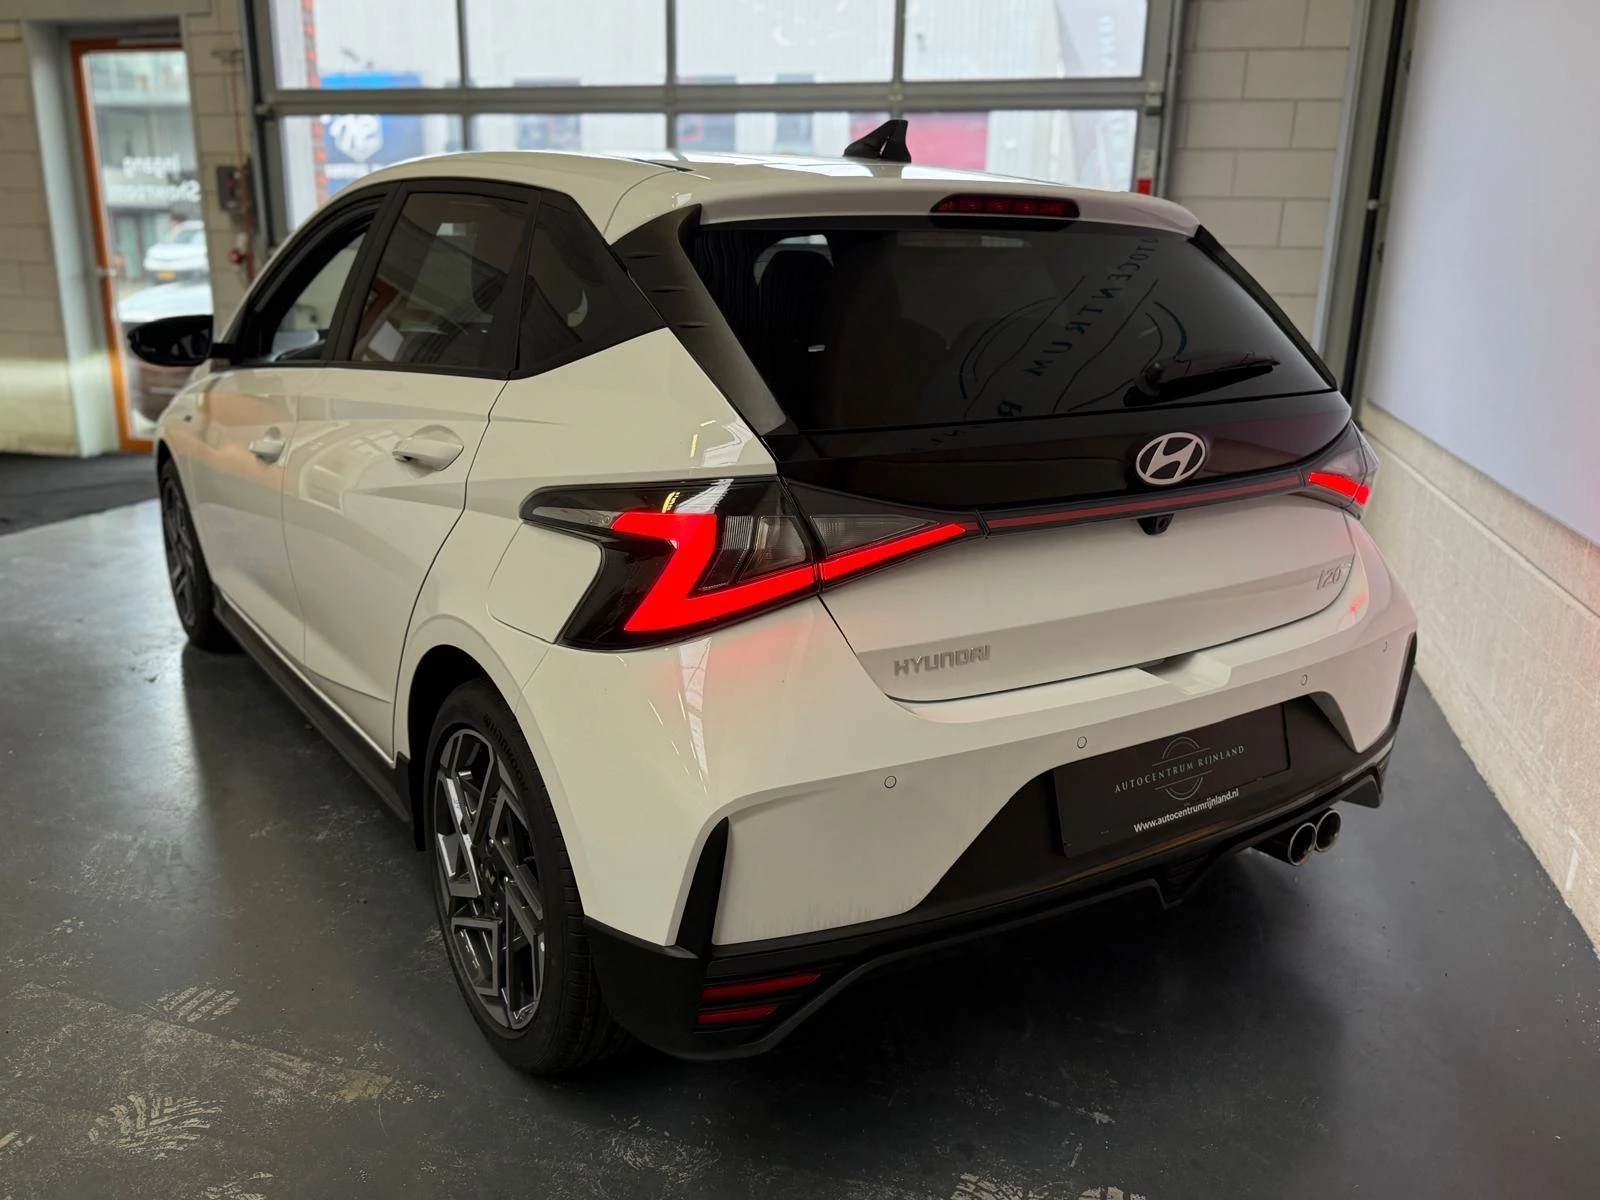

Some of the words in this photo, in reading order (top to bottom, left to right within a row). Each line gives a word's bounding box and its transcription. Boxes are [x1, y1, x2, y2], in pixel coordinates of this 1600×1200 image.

[1316, 566, 1342, 591] i20
[893, 643, 991, 677] HYUNDAI
[1114, 761, 1194, 794] AUTOCENTRUM
[1197, 745, 1245, 770] RIJNLAND
[1133, 788, 1239, 833] Www.autocentrumrijnland.nl
